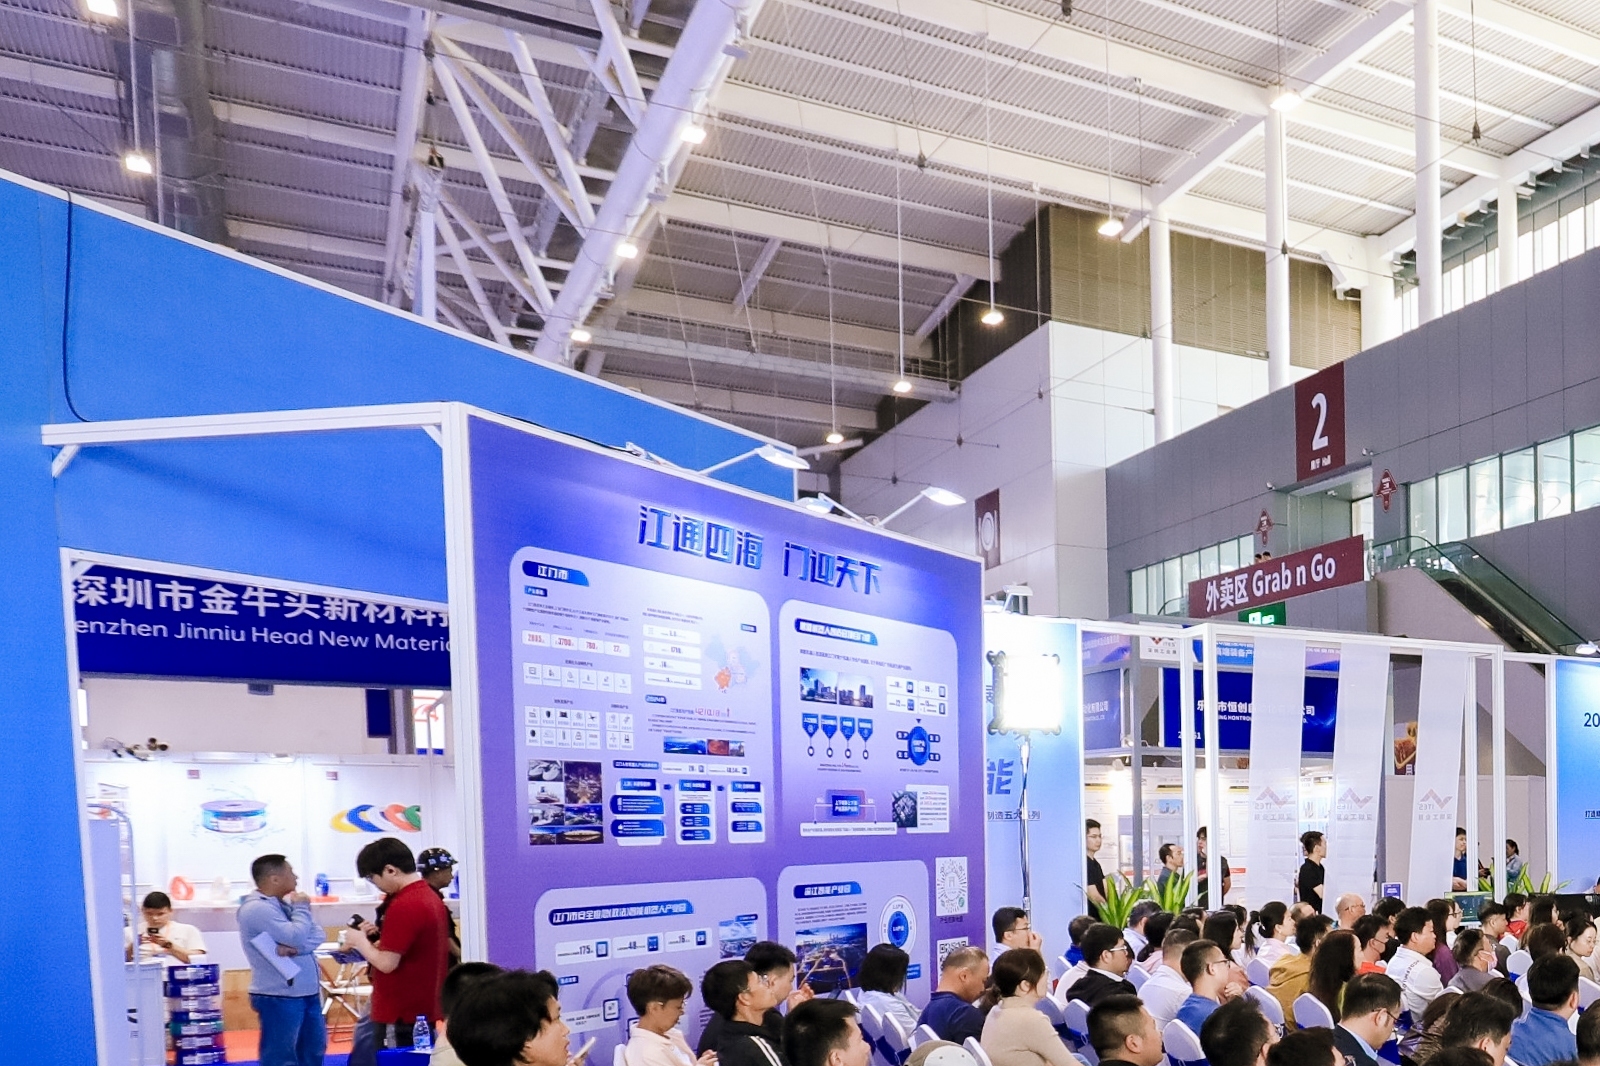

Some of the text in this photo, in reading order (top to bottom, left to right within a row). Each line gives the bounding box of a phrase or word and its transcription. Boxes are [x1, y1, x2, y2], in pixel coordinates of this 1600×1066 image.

[1311, 392, 1329, 451] 2
[637, 503, 883, 596] 江通四海 门迎天下
[1206, 552, 1336, 613] 外卖区 Grab n Go
[174, 621, 247, 643] Jinniu
[251, 626, 315, 646] Head
[319, 630, 369, 649] New
